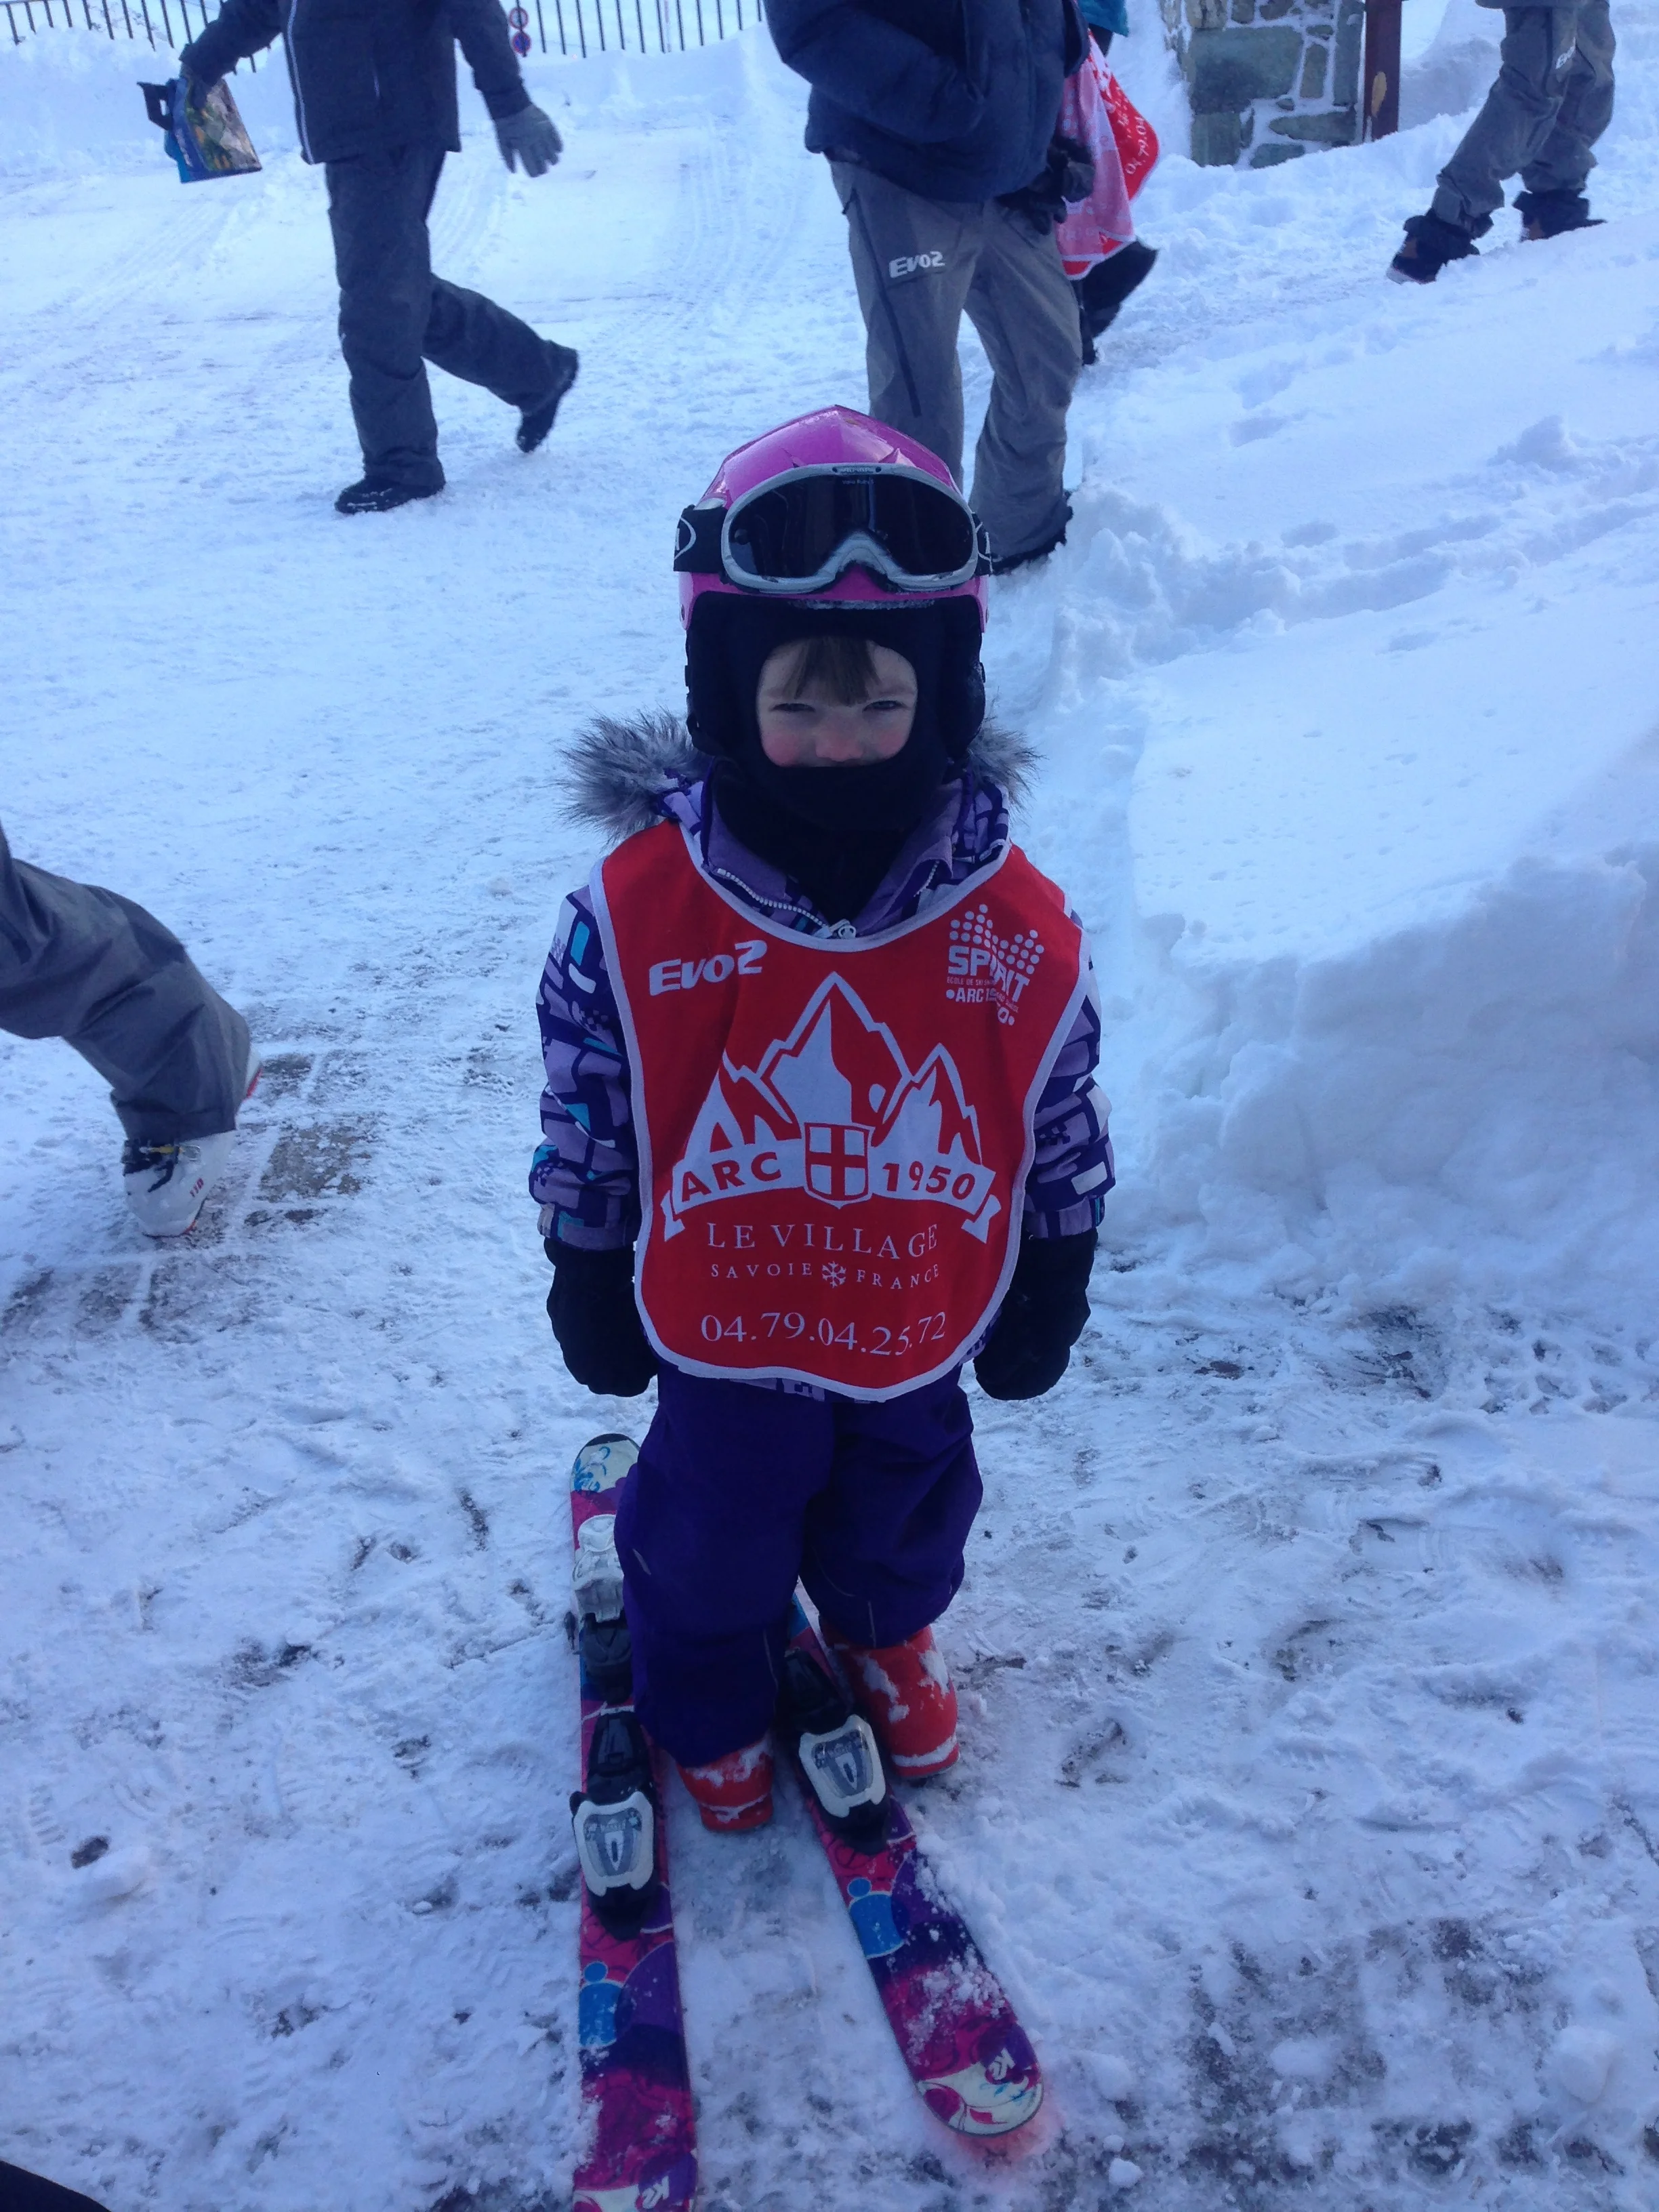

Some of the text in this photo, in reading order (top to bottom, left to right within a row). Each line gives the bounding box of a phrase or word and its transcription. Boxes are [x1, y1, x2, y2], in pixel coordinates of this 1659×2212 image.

[955, 987, 984, 1003] ARC
[682, 1151, 976, 1202] ARC 1950
[707, 1222, 938, 1259] LE VILLAGE
[711, 1263, 940, 1290] SAVOIE FRANCE
[701, 1311, 946, 1356] 04.79.04.25.72
